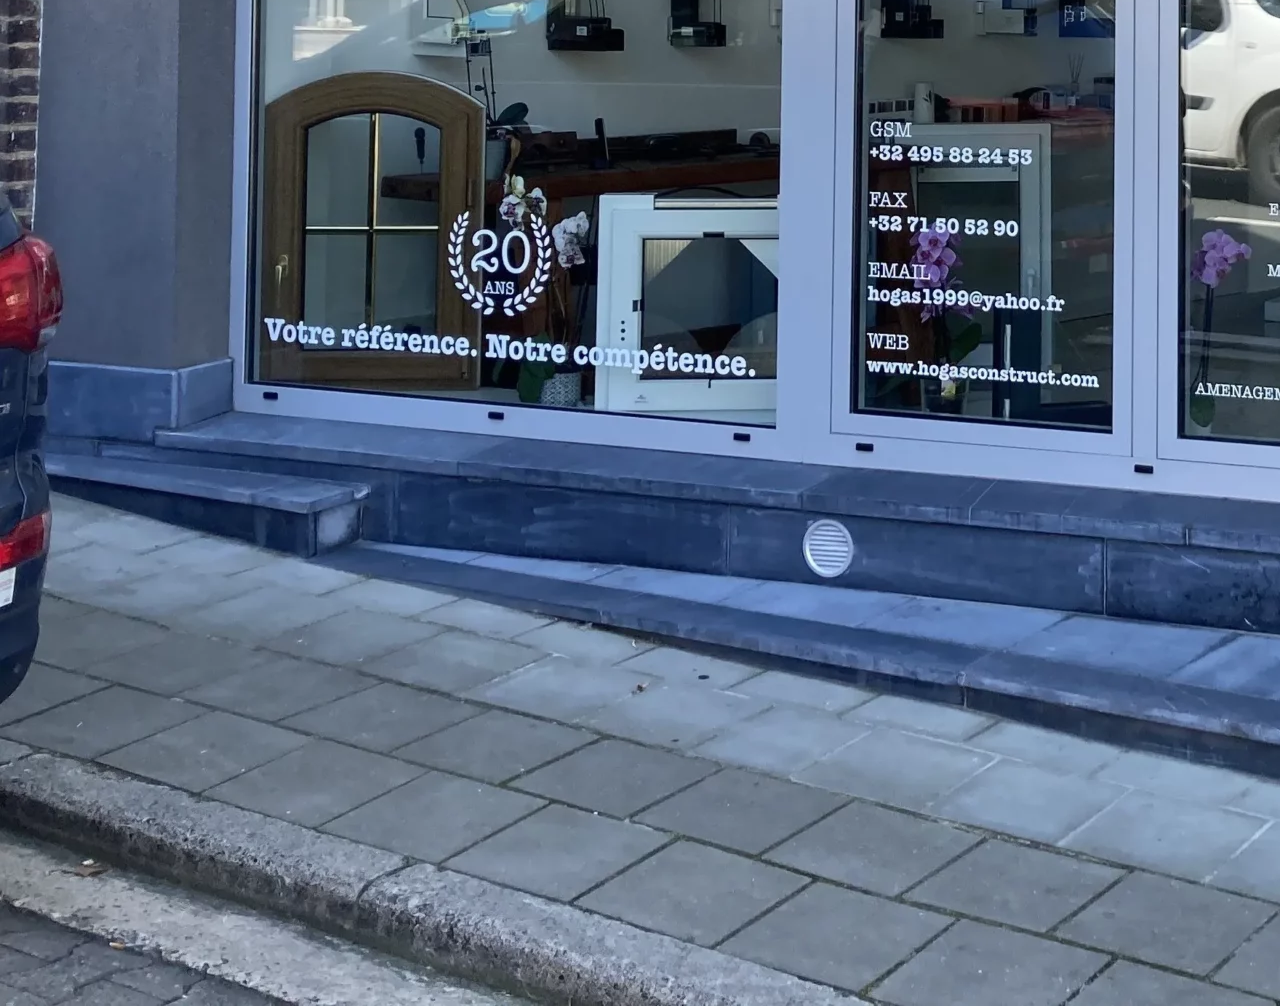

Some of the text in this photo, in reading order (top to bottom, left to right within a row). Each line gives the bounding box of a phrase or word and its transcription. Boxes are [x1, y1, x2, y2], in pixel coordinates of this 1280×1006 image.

[870, 122, 912, 138] GSM
[870, 145, 1033, 165] +32 495 88 24 53
[869, 191, 908, 209] FAX
[869, 215, 1019, 237] +32 71 50 52 90
[471, 229, 530, 274] 20
[868, 262, 931, 281] EMAIL
[483, 281, 515, 295] ANS
[867, 285, 1065, 312] hogas1999@yahoo.fr
[264, 317, 756, 378] Votre référence. Notre compétence.
[867, 333, 909, 350] WEB
[867, 359, 1099, 388] www.hogasconstruct.com
